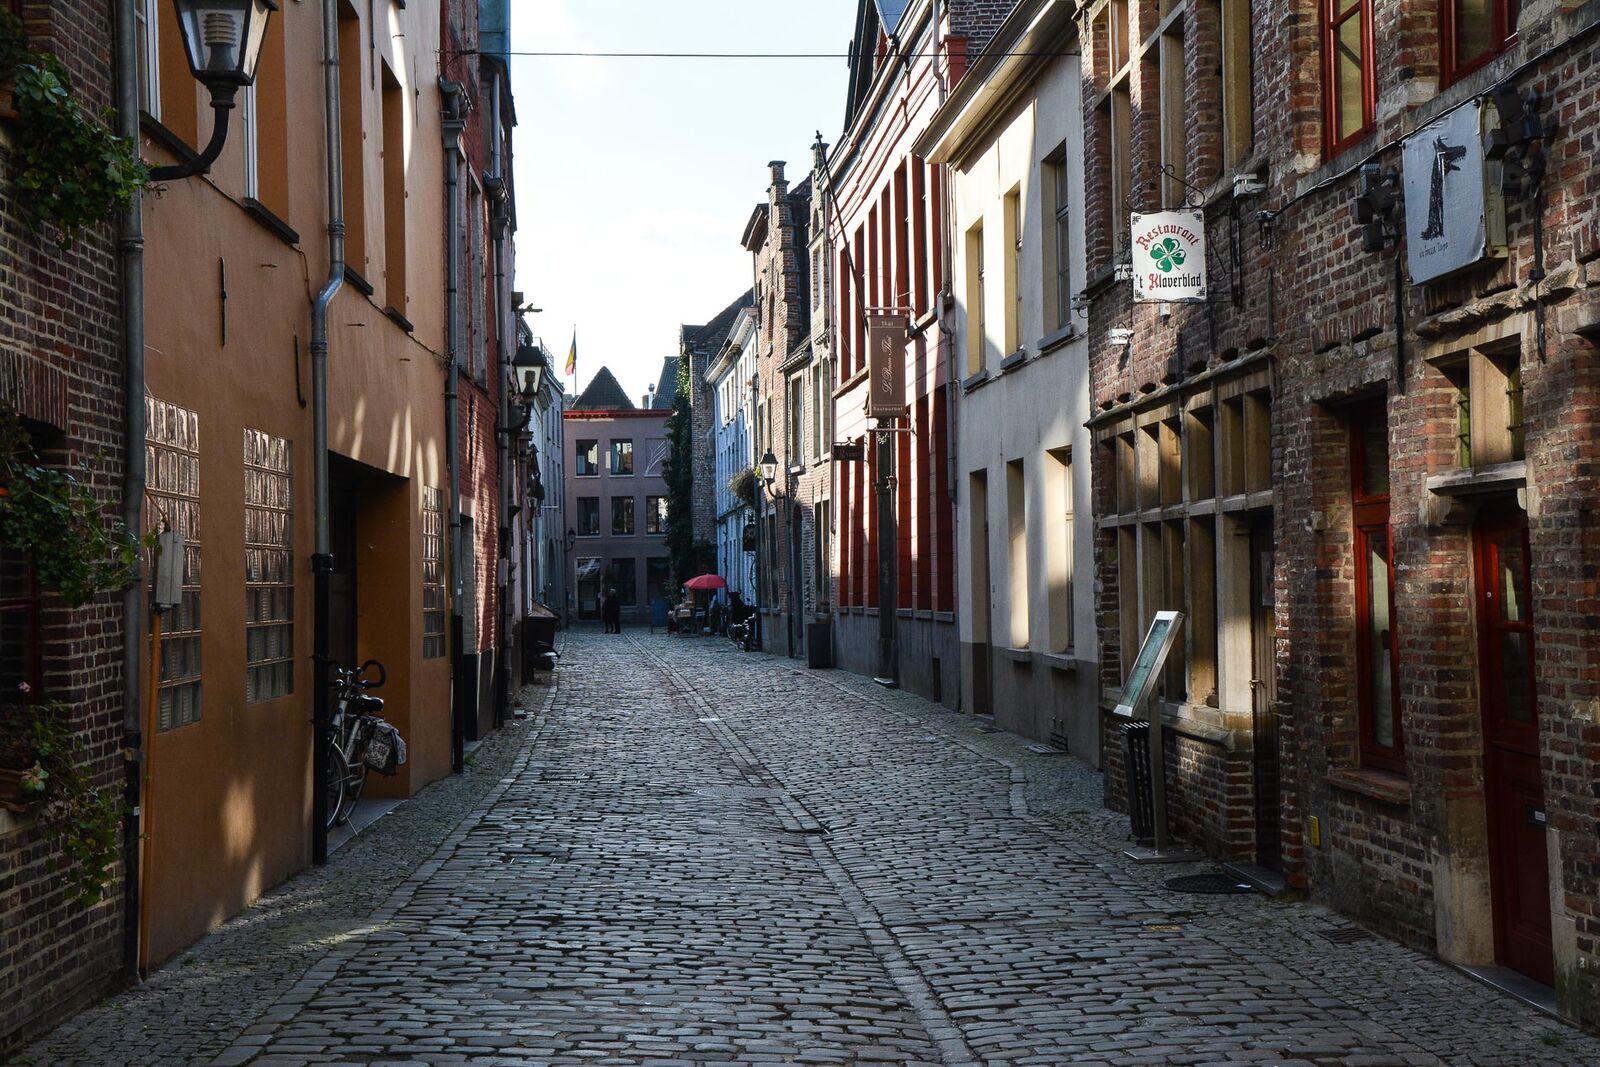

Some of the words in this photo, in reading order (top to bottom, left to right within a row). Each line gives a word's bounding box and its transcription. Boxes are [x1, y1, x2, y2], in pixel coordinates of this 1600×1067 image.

[1135, 224, 1200, 251] Restaurant
[1135, 273, 1143, 289] 't
[1149, 272, 1202, 291] Klaverblad
